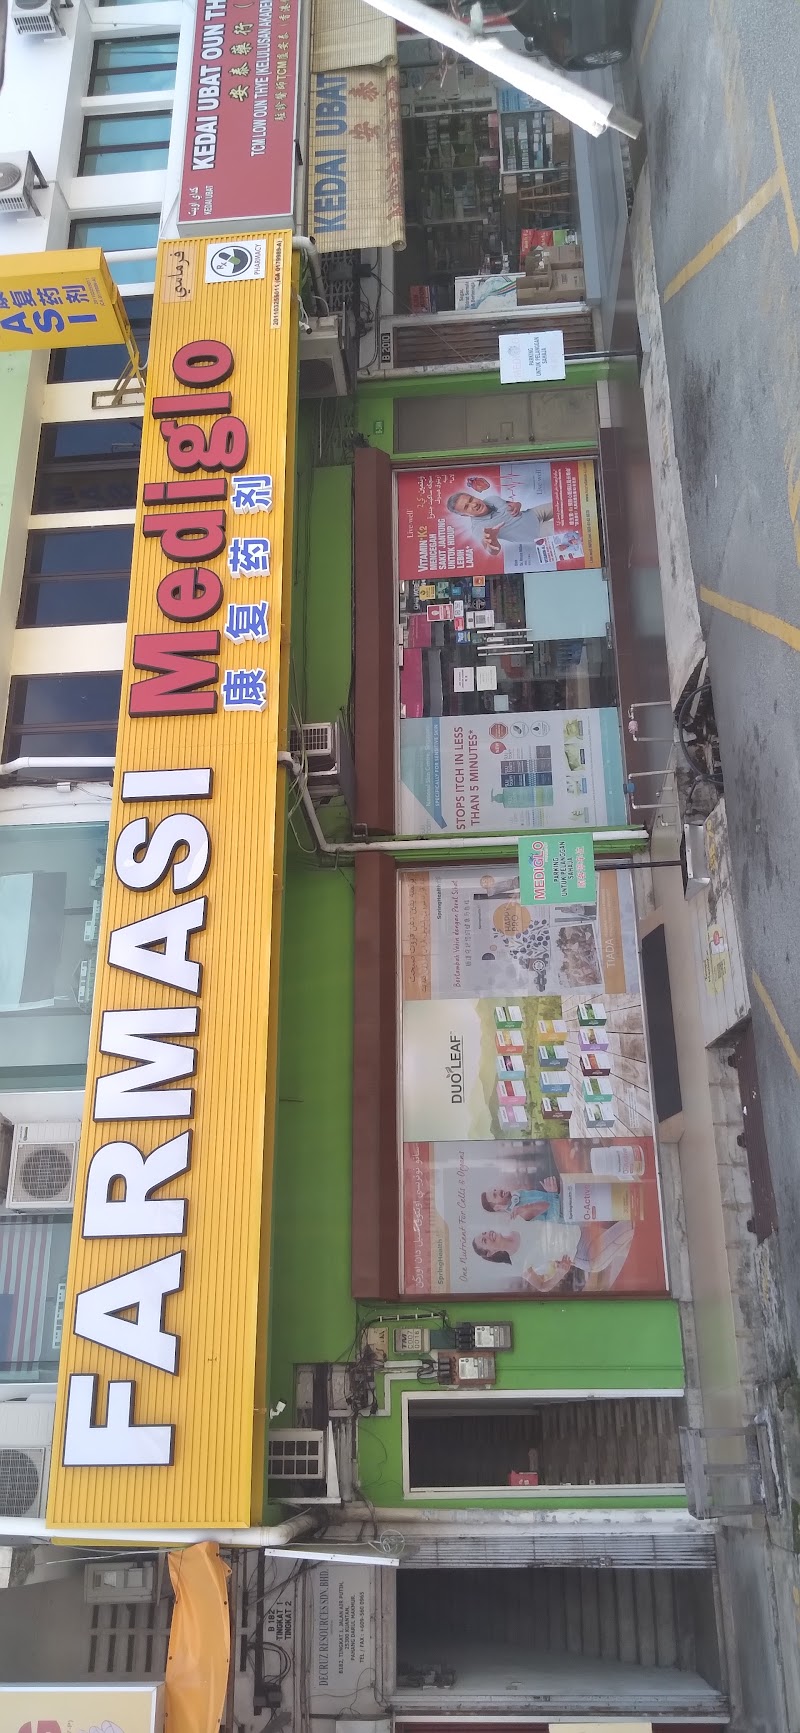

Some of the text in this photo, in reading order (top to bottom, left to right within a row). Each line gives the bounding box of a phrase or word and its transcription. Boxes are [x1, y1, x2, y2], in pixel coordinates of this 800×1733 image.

[202, 24, 226, 60] OUN
[256, 28, 273, 75] (KELULUSAN
[196, 65, 222, 112] UBAT
[254, 76, 270, 99] THYE
[253, 100, 268, 118] OUN
[348, 80, 380, 142] 安泰
[191, 116, 218, 171] KEDAI
[252, 119, 267, 137] LOW
[250, 138, 266, 157] TCM
[314, 74, 348, 234] KEDAI UBAT
[204, 185, 214, 216] KEDAI UBAT
[168, 251, 190, 298] فرماسي
[254, 244, 262, 276] PHARMACY
[533, 336, 541, 361] PELANGGAN
[429, 533, 438, 570] MENCEGAH
[438, 518, 447, 570] SAKIT JANTUNG
[447, 525, 456, 570] UNTUK HIDUP
[456, 549, 465, 568] LEBIH
[220, 473, 273, 712] 康复药剂
[454, 726, 466, 830] STOPS ITCH IN LESS
[470, 795, 480, 826] THAN
[532, 841, 546, 900] MEDIGLO
[552, 857, 560, 882] PARKING
[560, 876, 568, 897] UNTUK
[62, 338, 248, 1468] FARMASI Mediglo
[504, 907, 512, 932] HAPPY
[511, 914, 519, 932] PRO
[604, 938, 616, 968] TIADA
[450, 1035, 462, 1104] DUO LEAF
[456, 1150, 470, 1177] Organs
[456, 1188, 467, 1208] Cells
[458, 1210, 467, 1224] For
[458, 1227, 468, 1264] Nutrient
[459, 1266, 468, 1282] One
[402, 1334, 407, 1349] TM
[276, 1608, 284, 1640] TINGKAT
[284, 1608, 292, 1640] TINGKAT
[318, 1605, 329, 1652] RESOURCES
[318, 1654, 329, 1686] DECRUZ
